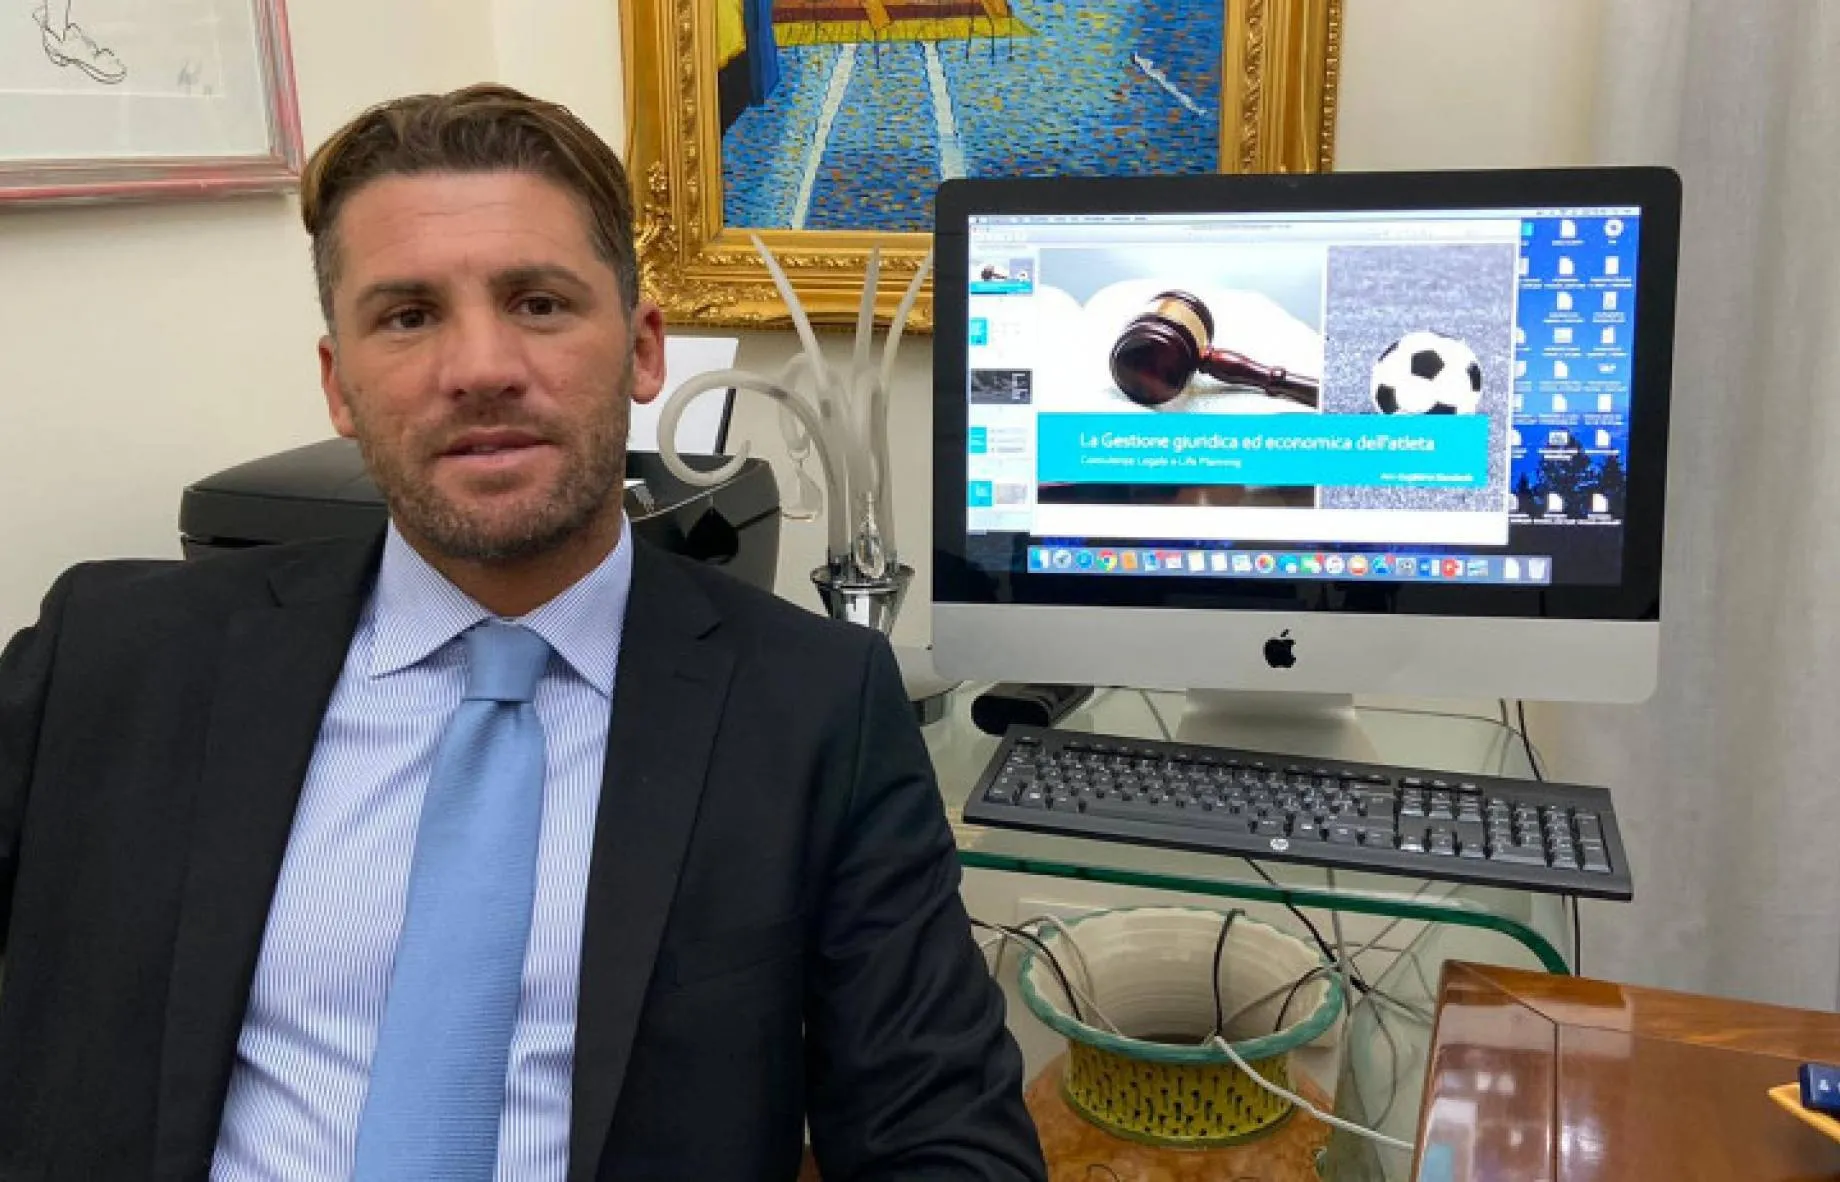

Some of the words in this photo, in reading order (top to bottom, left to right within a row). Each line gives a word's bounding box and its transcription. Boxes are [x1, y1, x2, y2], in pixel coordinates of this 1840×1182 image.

[1079, 431, 1097, 449] La
[1101, 431, 1168, 449] Gestione
[1172, 433, 1239, 453] giuridica
[1242, 432, 1261, 450] ed
[1264, 436, 1352, 450] economica
